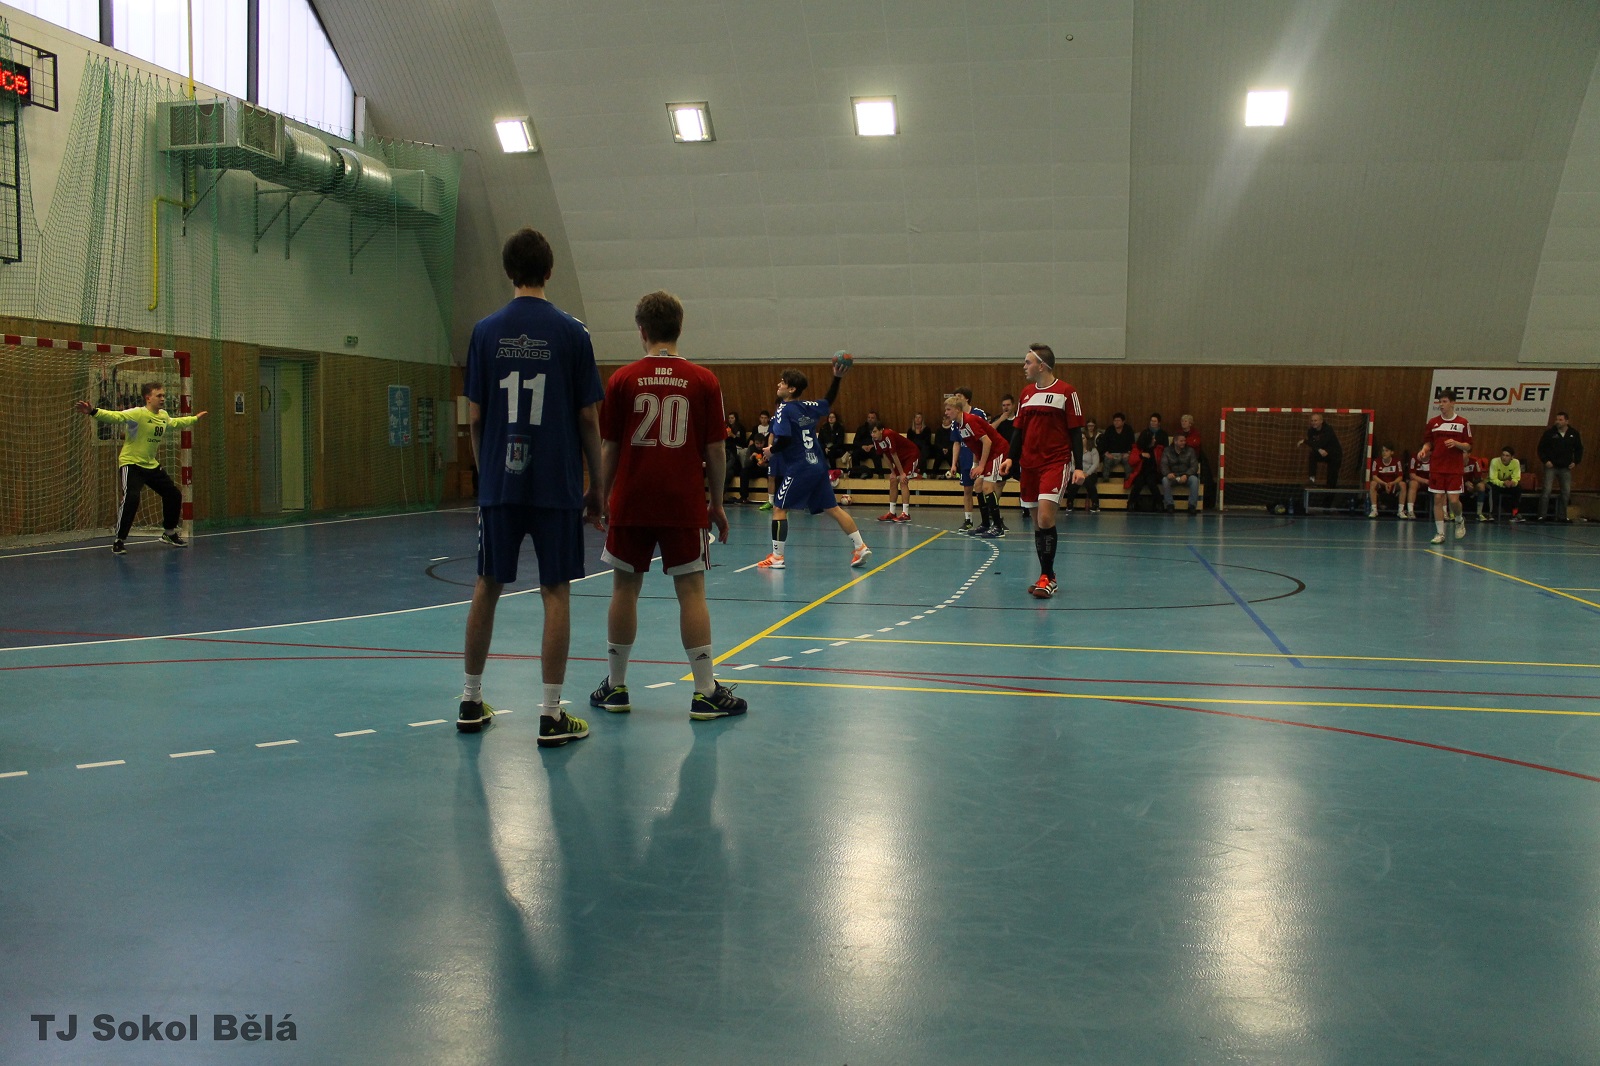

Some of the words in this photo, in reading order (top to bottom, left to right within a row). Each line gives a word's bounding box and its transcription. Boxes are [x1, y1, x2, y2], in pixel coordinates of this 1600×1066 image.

[495, 347, 551, 361] ATMOS
[654, 367, 673, 376] HBC
[637, 376, 689, 389] STRAKONICE
[499, 371, 547, 426] 11
[1045, 393, 1054, 404] 10
[630, 392, 690, 449] 20
[154, 426, 163, 437] 89
[801, 429, 814, 450] 5
